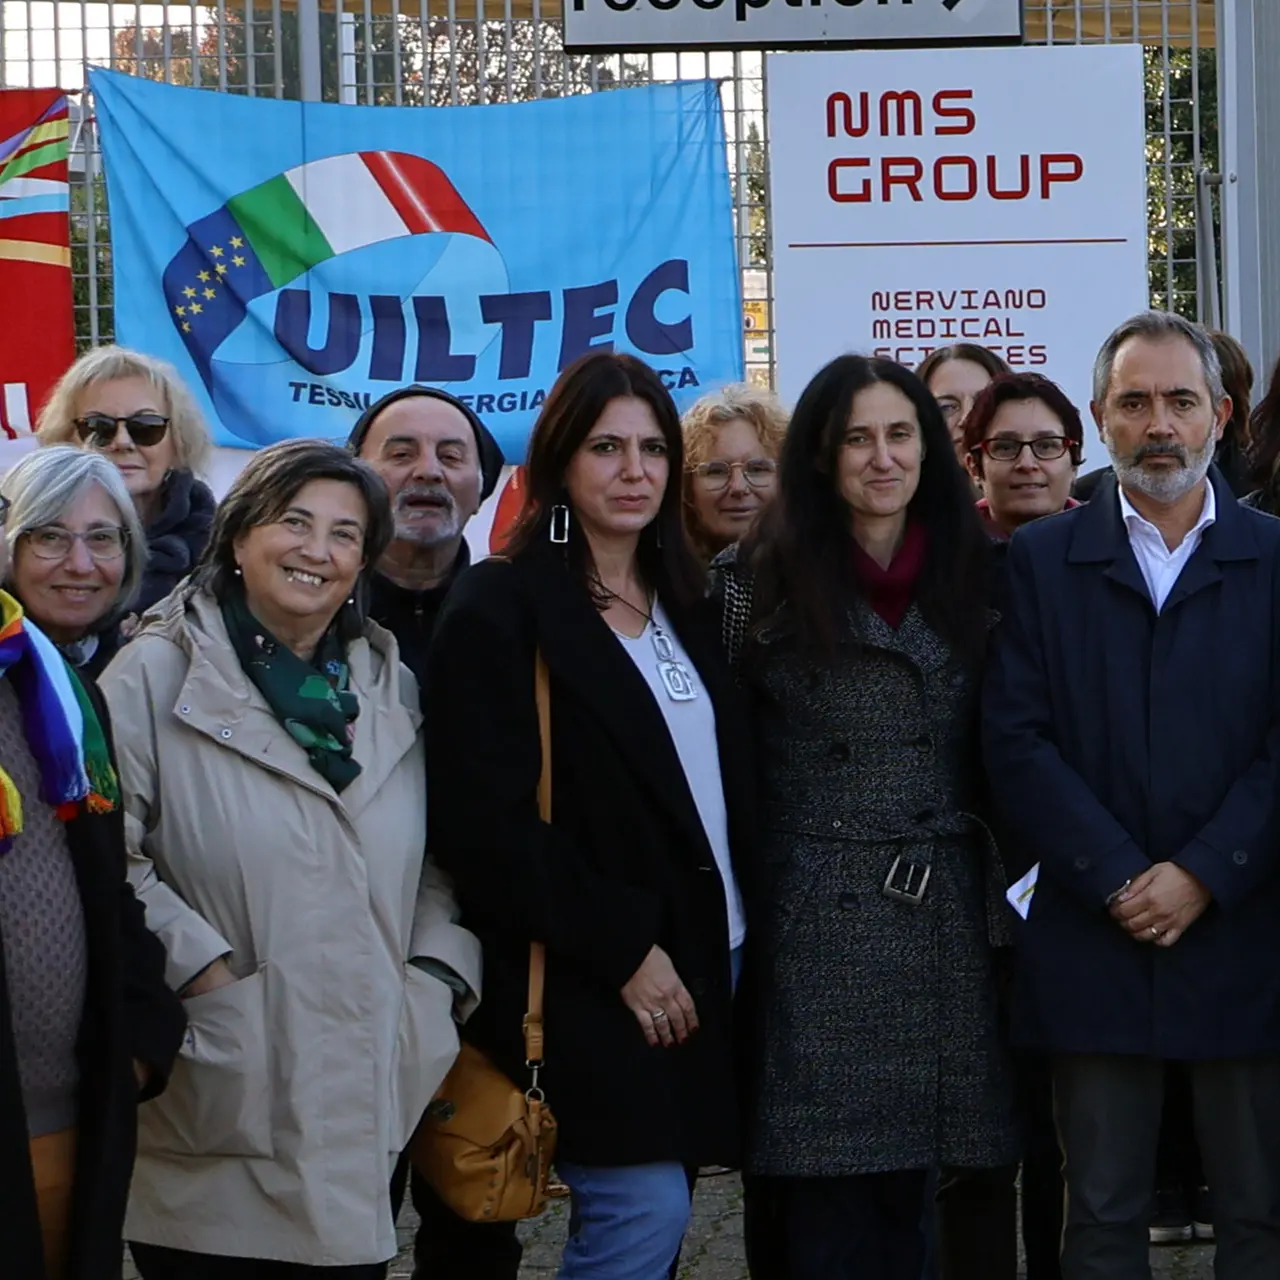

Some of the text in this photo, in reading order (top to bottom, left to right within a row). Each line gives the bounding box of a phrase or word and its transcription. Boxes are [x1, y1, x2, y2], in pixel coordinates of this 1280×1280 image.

[826, 89, 976, 138] NMS
[827, 153, 1083, 203] GROUP
[871, 289, 1047, 311] NERVIANO
[273, 258, 695, 383] UILTEC
[872, 317, 1025, 339] MEDICAL
[873, 345, 1047, 365] SCIES
